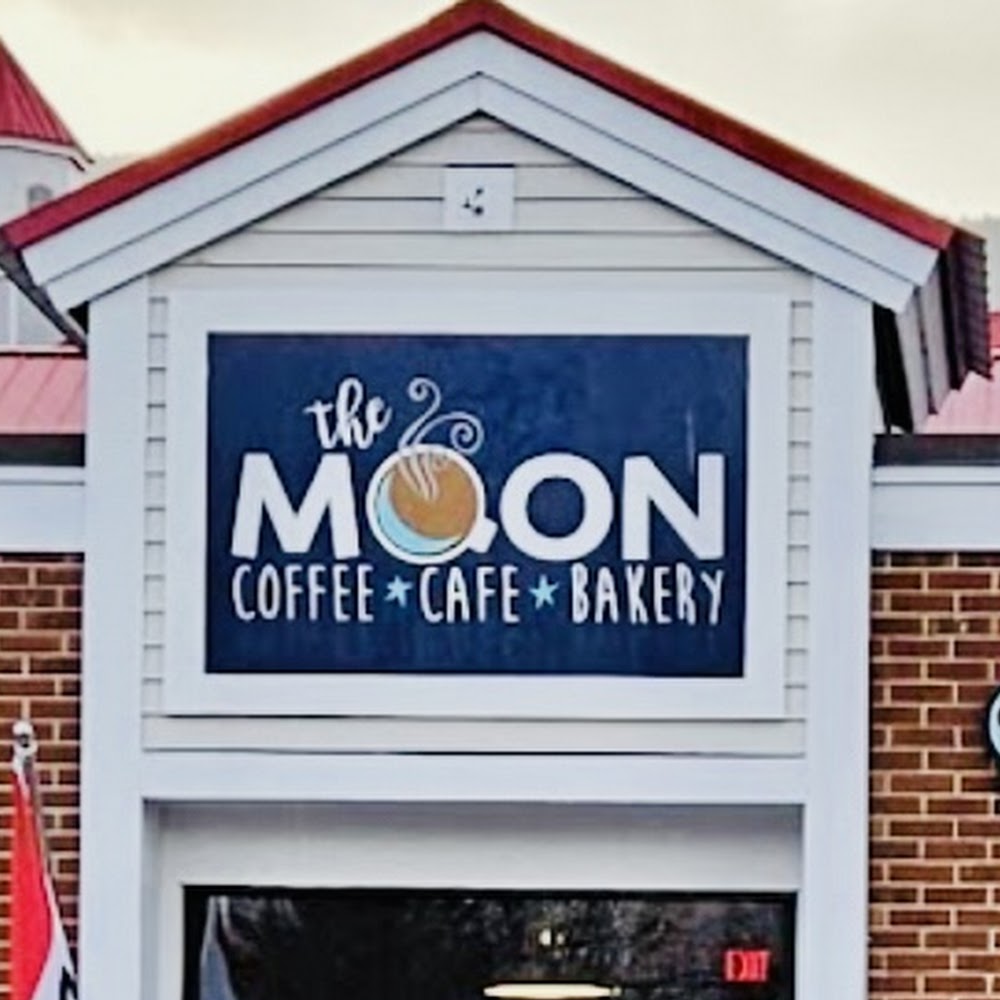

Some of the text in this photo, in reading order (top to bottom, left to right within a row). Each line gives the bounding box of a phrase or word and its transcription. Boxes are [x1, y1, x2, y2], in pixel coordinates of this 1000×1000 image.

[303, 377, 391, 449] the
[231, 443, 726, 565] MOON
[231, 562, 725, 625] COFFEE CAFE BAKERY
